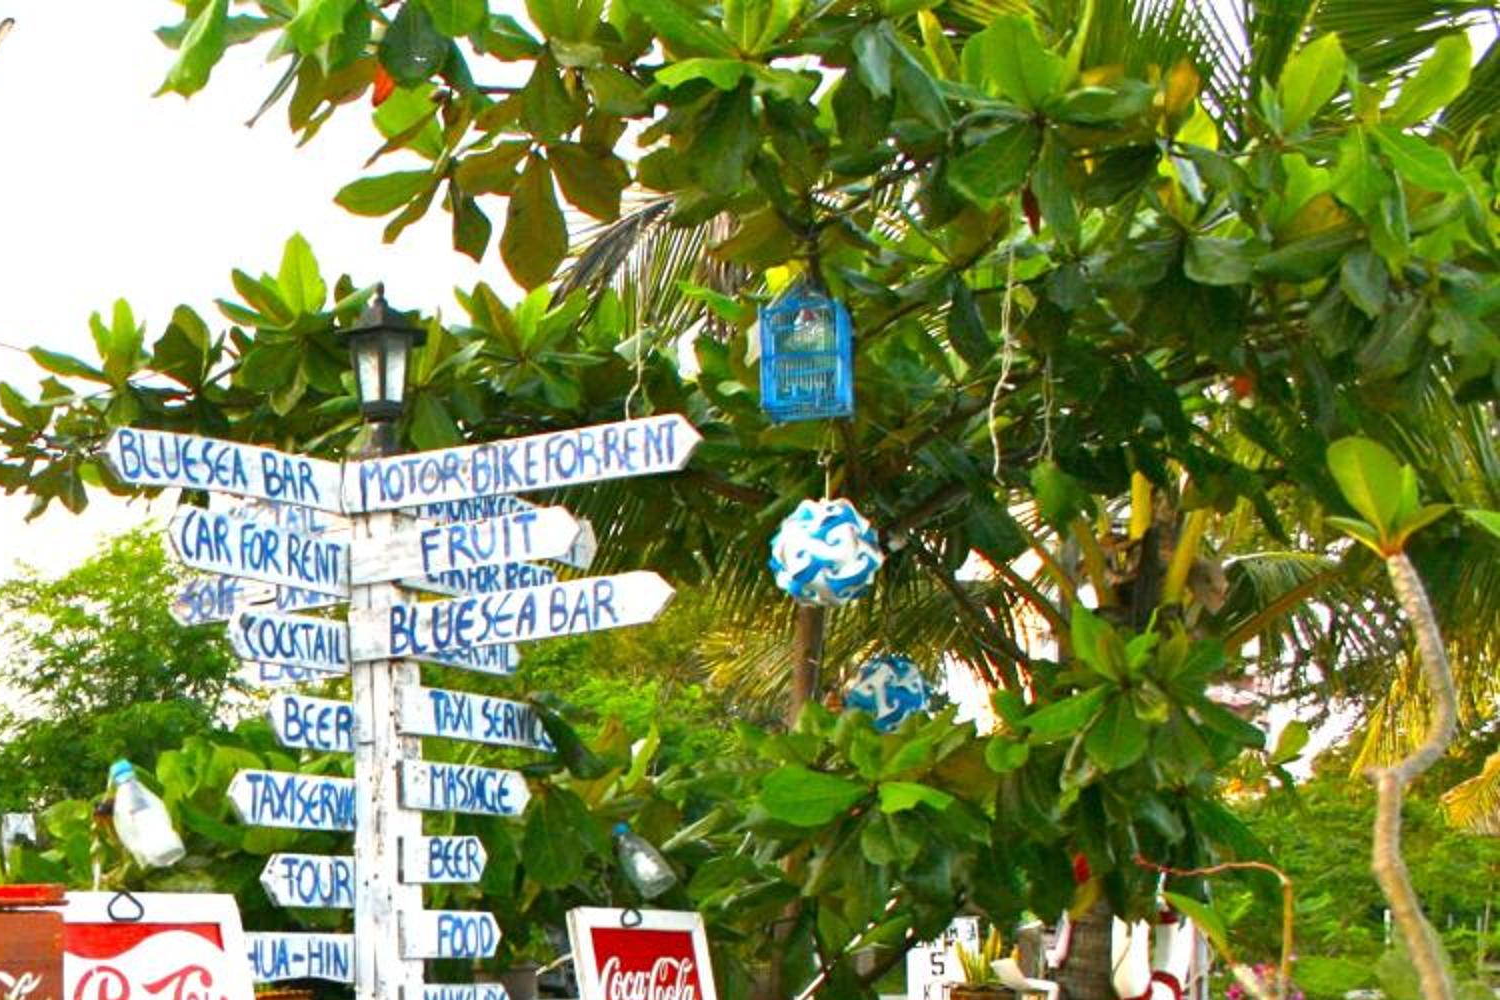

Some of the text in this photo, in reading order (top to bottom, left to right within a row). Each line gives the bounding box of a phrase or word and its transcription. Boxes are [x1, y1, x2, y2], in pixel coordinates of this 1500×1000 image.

[261, 451, 320, 504] BAR
[181, 509, 342, 586] CAR FOR RENT
[420, 511, 538, 573] FRUIT
[548, 579, 620, 634] BAR
[240, 611, 346, 665] COCKTAIL
[282, 695, 354, 751] BEER
[428, 690, 473, 737] TAXI
[281, 858, 353, 905] TOUR
[428, 837, 480, 880] BEER
[437, 914, 494, 957] FOOD
